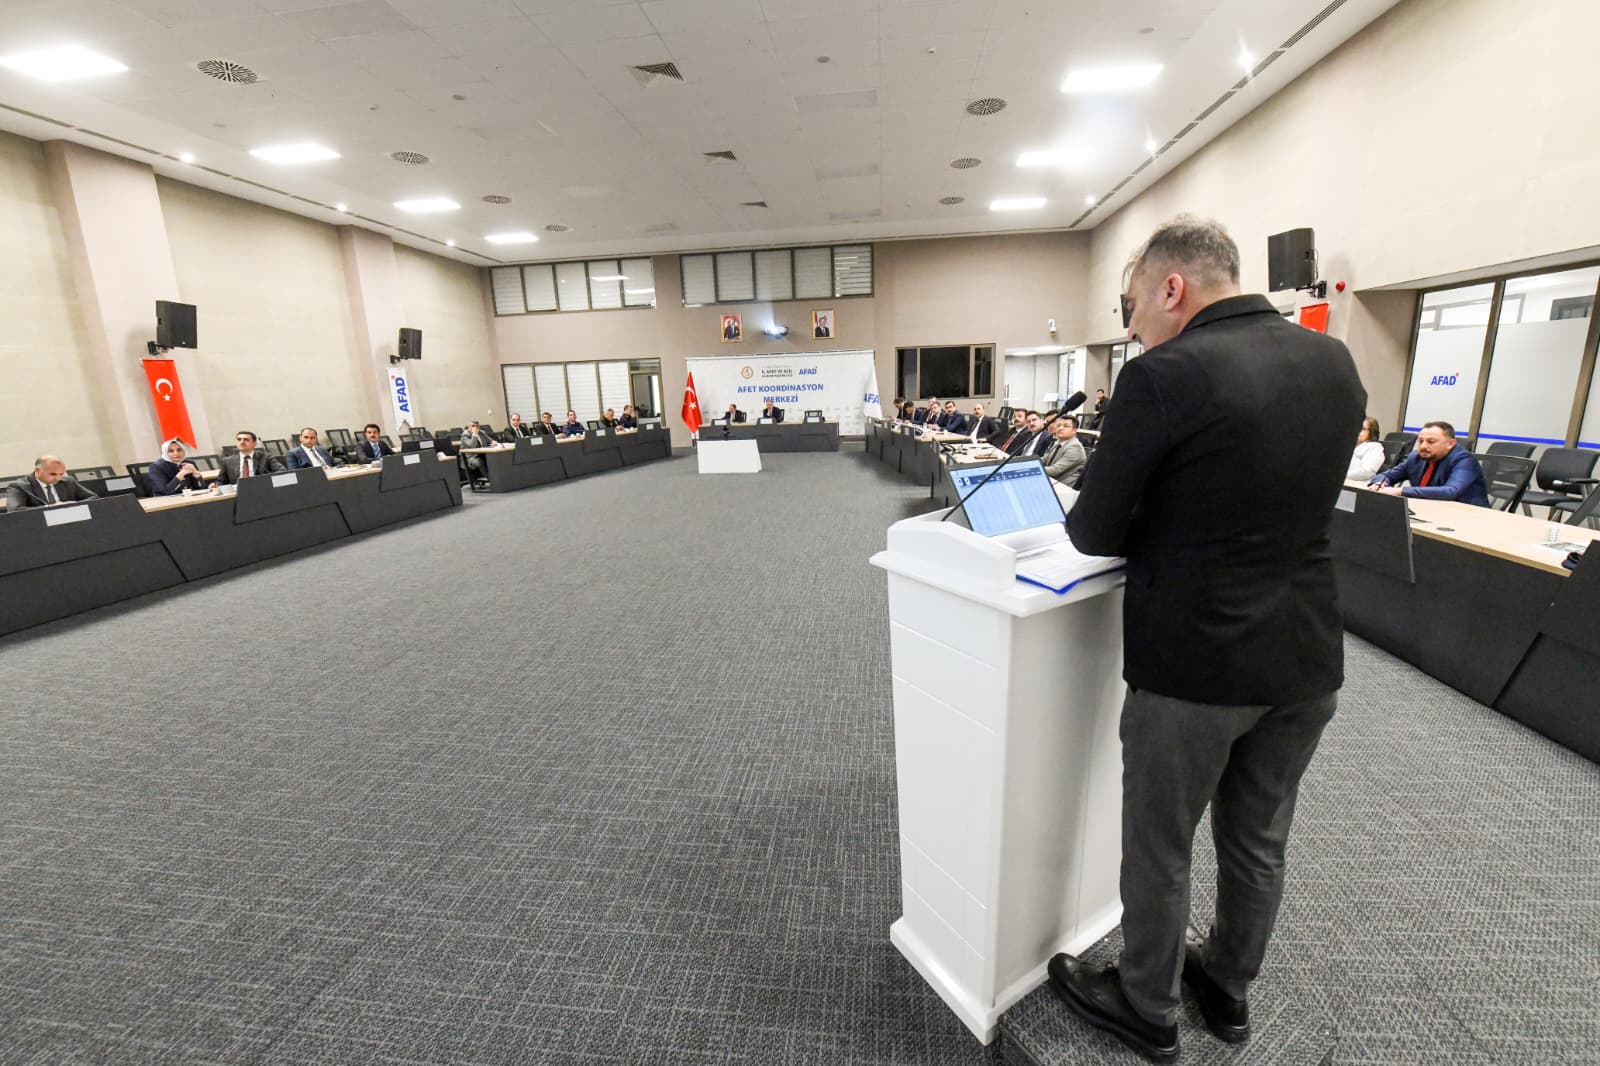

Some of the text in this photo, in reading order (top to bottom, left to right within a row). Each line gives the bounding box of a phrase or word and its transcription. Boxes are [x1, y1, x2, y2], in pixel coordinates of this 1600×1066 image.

[1430, 375, 1457, 386] AFAD
[737, 384, 824, 393] AFET KOORDİNASYON
[395, 377, 410, 413] AFAD
[763, 394, 798, 403] MERKEZİ
